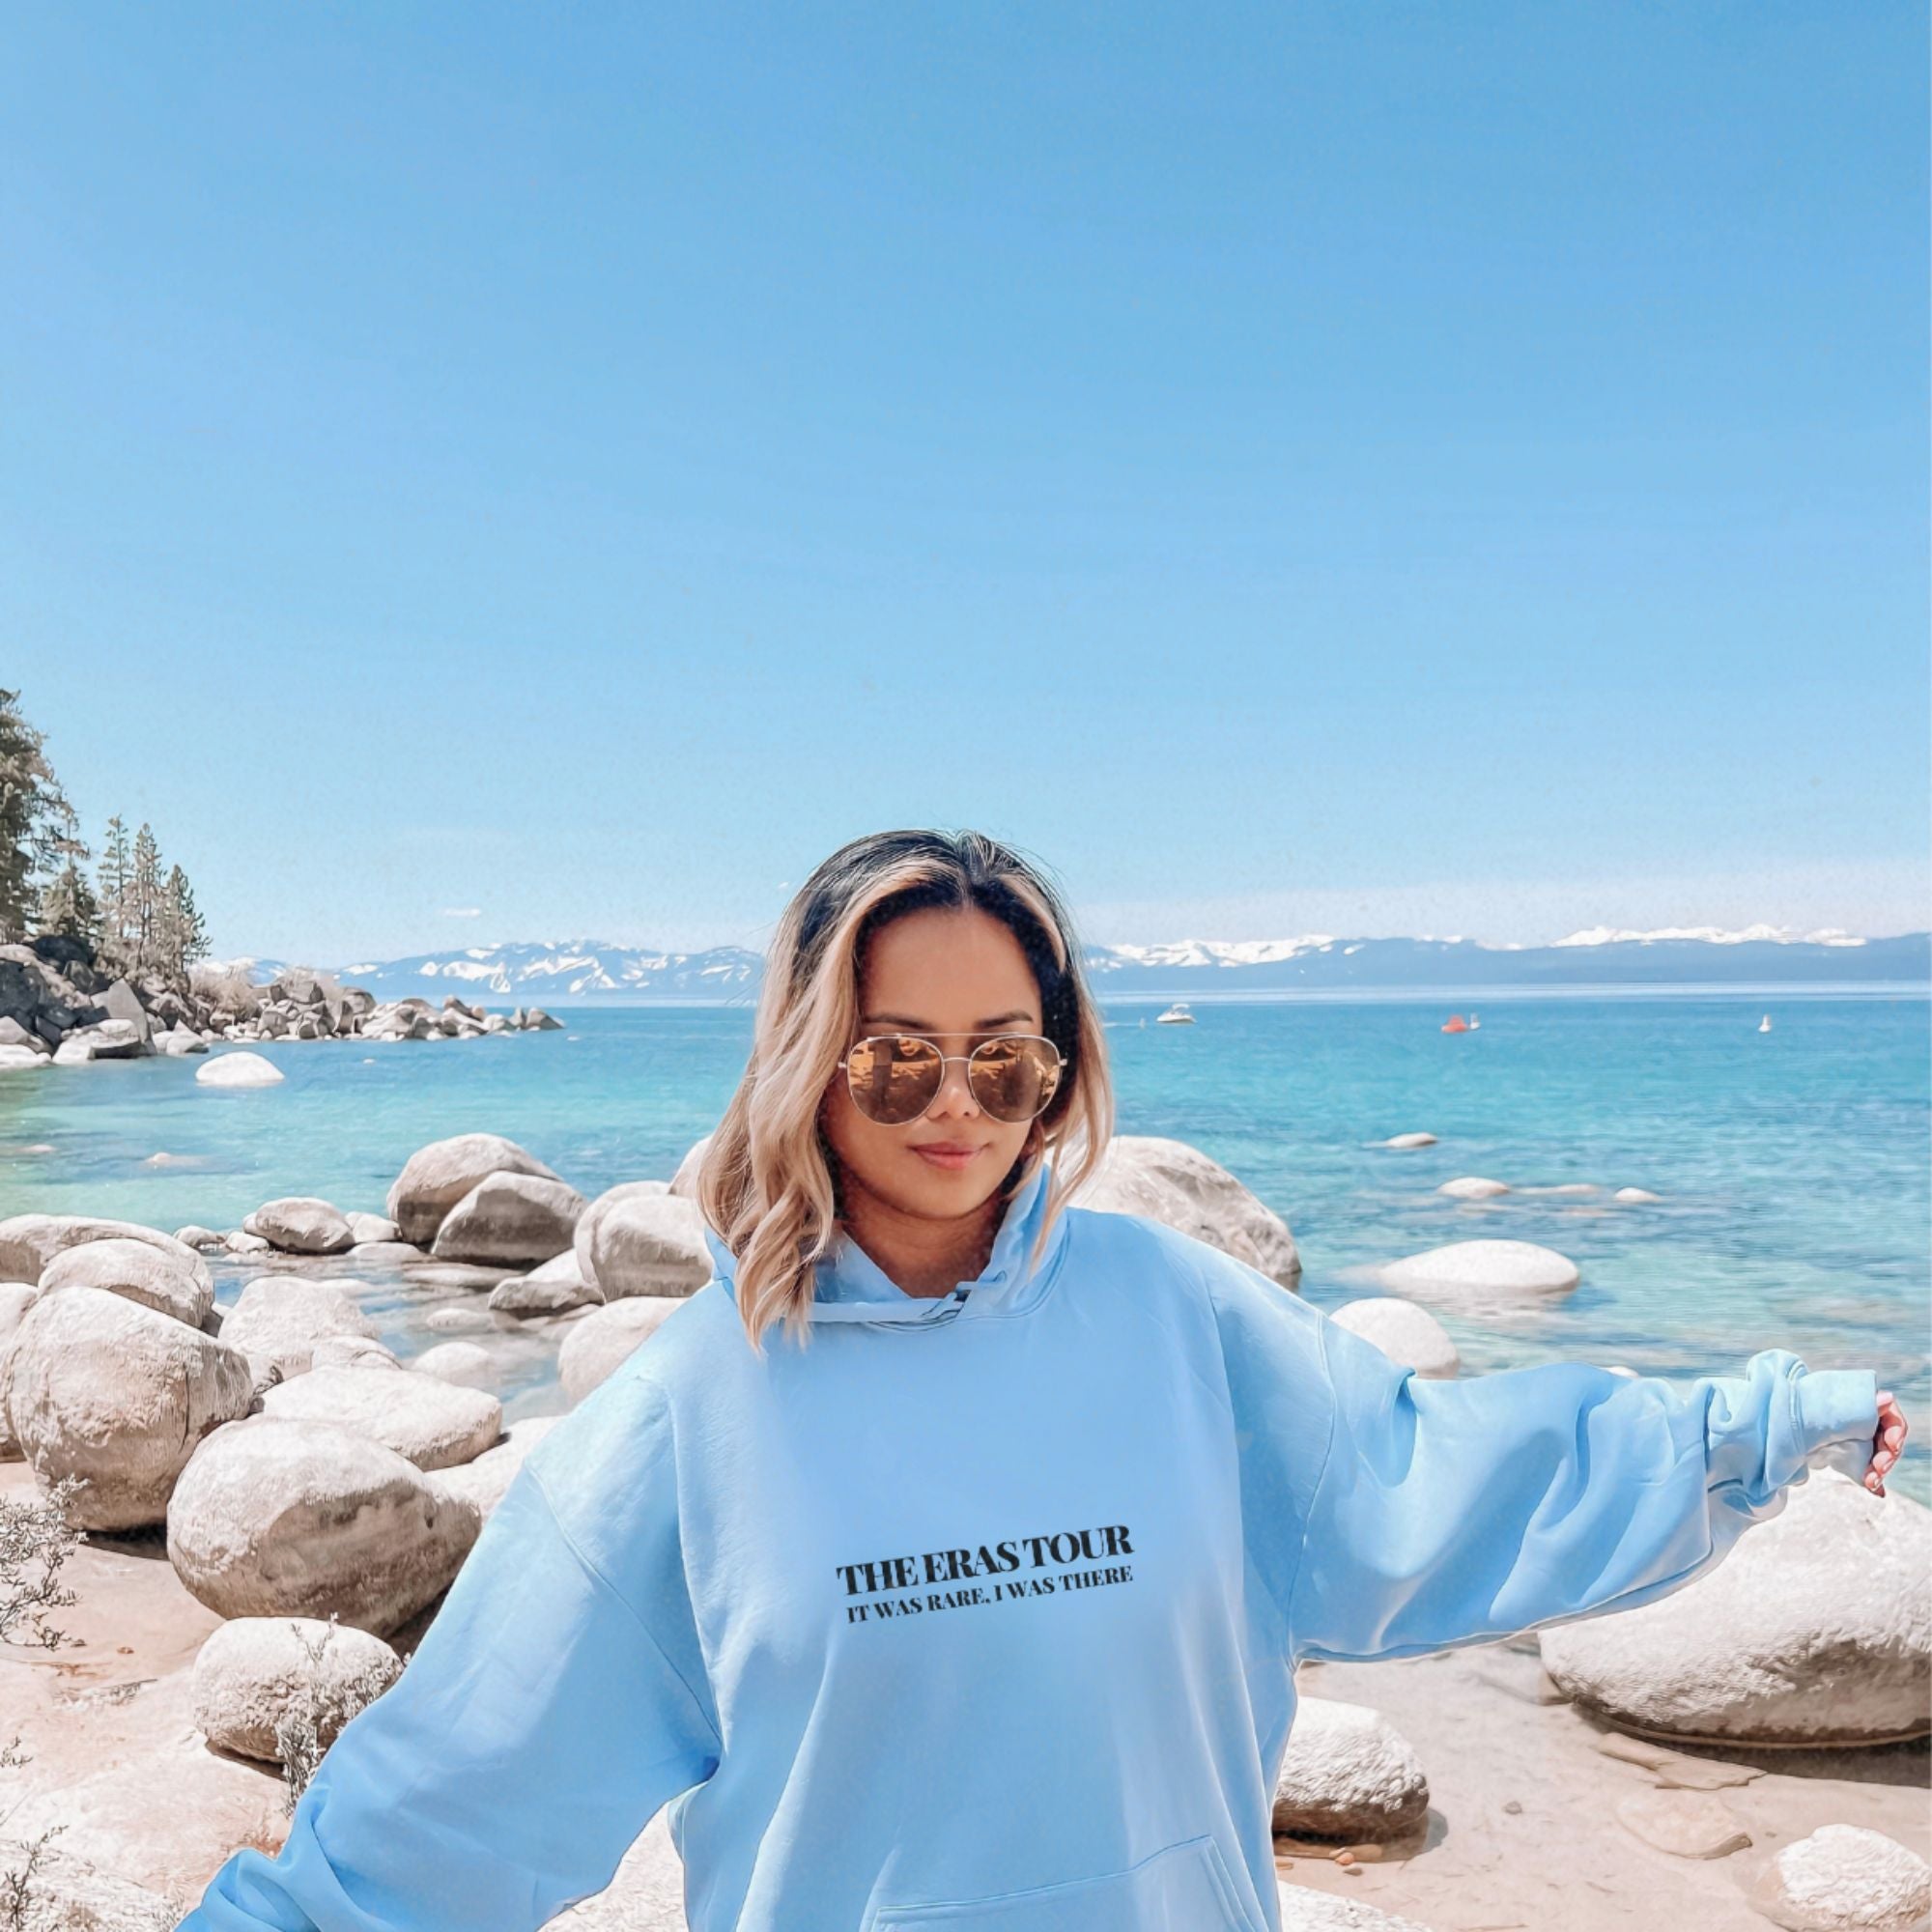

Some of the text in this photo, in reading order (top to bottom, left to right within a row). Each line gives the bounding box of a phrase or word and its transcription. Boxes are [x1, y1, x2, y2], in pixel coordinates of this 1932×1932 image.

[836, 1525, 1135, 1596] THE ERAS TOUR
[847, 1604, 869, 1624] IT
[874, 1597, 923, 1619] WAS
[994, 1584, 1003, 1602] I
[1006, 1576, 1055, 1599] WAS
[1059, 1566, 1134, 1591] THERE
